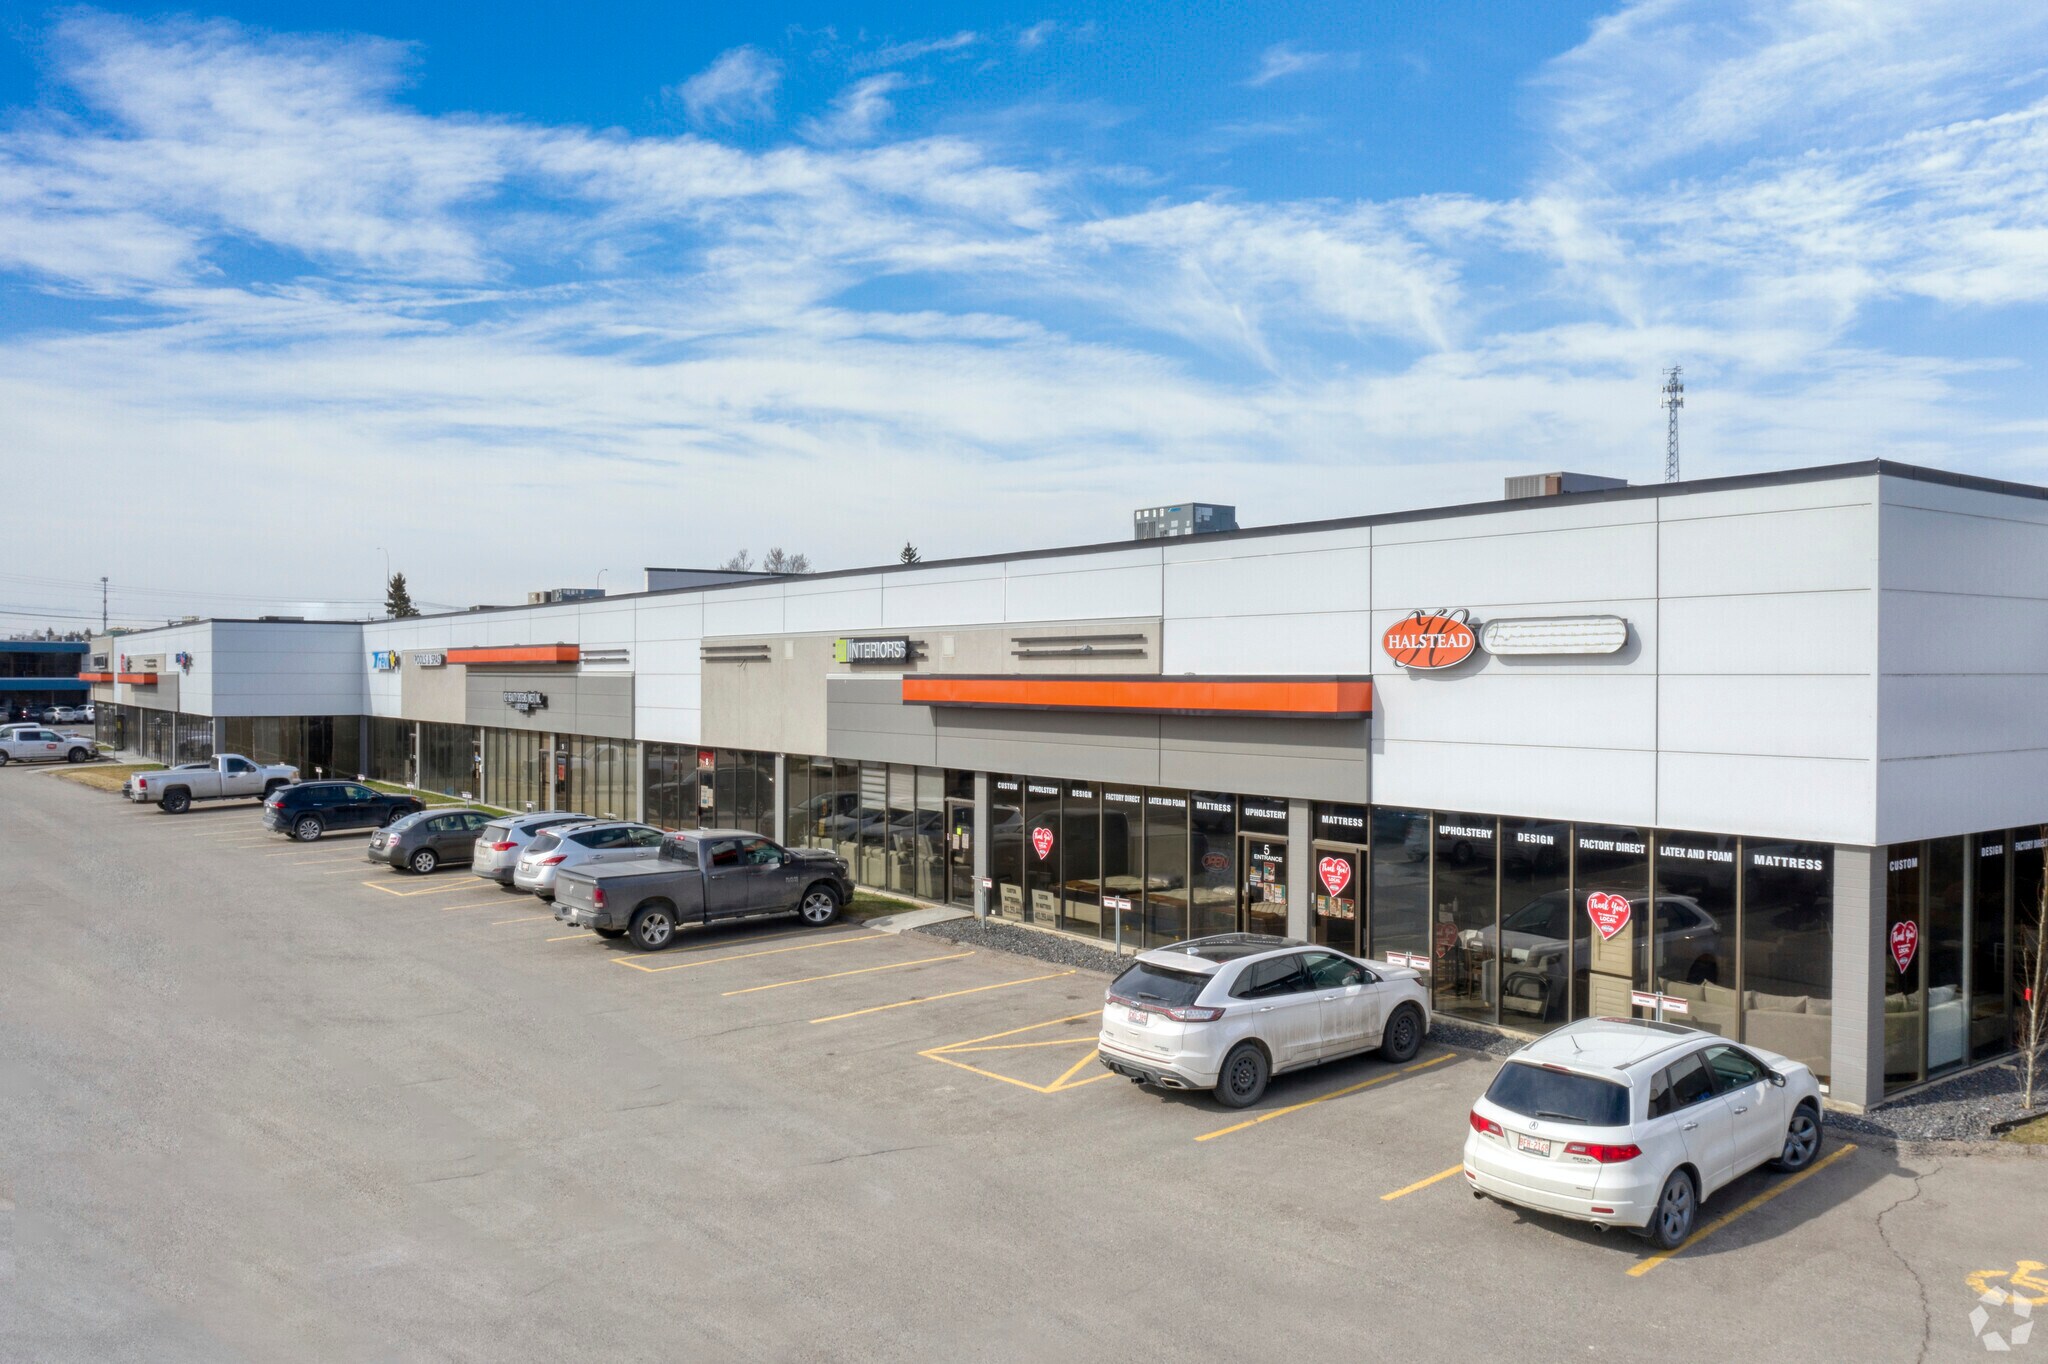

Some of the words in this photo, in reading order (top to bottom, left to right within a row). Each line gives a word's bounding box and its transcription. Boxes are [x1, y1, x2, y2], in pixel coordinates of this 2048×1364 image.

[1388, 633, 1471, 649] HALSTEAD
[849, 640, 905, 659] INTERIORS
[997, 781, 1018, 791] CUSTOM
[1028, 785, 1059, 795] UPHOLSTERY
[1071, 789, 1093, 799] DESIGN
[1105, 793, 1124, 802] FACTORY
[1124, 795, 1141, 803] DIRECT
[1148, 797, 1162, 805] LATEX
[1162, 798, 1172, 806] AND
[1172, 799, 1186, 808] FOAM
[1196, 801, 1232, 813] MATTRESS
[1245, 807, 1287, 820] UPHOLSTERY
[1321, 815, 1363, 828] MATTRESS
[1439, 825, 1492, 839] UPHOLSTERY
[1517, 832, 1554, 845] DESIGN
[1263, 844, 1270, 856] 5
[1579, 838, 1615, 851] FACTORY
[1616, 842, 1646, 854] DIRECT
[1981, 844, 2003, 857] DESIGN
[2015, 840, 2033, 852] FACTORY
[1253, 853, 1283, 863] ENTRANCE
[1660, 846, 1686, 858] LATEX
[1687, 848, 1705, 860] AND
[1707, 850, 1733, 863] FOAM
[1754, 854, 1823, 871] MATTRESS
[1889, 857, 1918, 872] CUSTOM
[1590, 898, 1610, 911] Thank
[1611, 901, 1628, 915] You!
[1599, 915, 1617, 923] LOCAL
